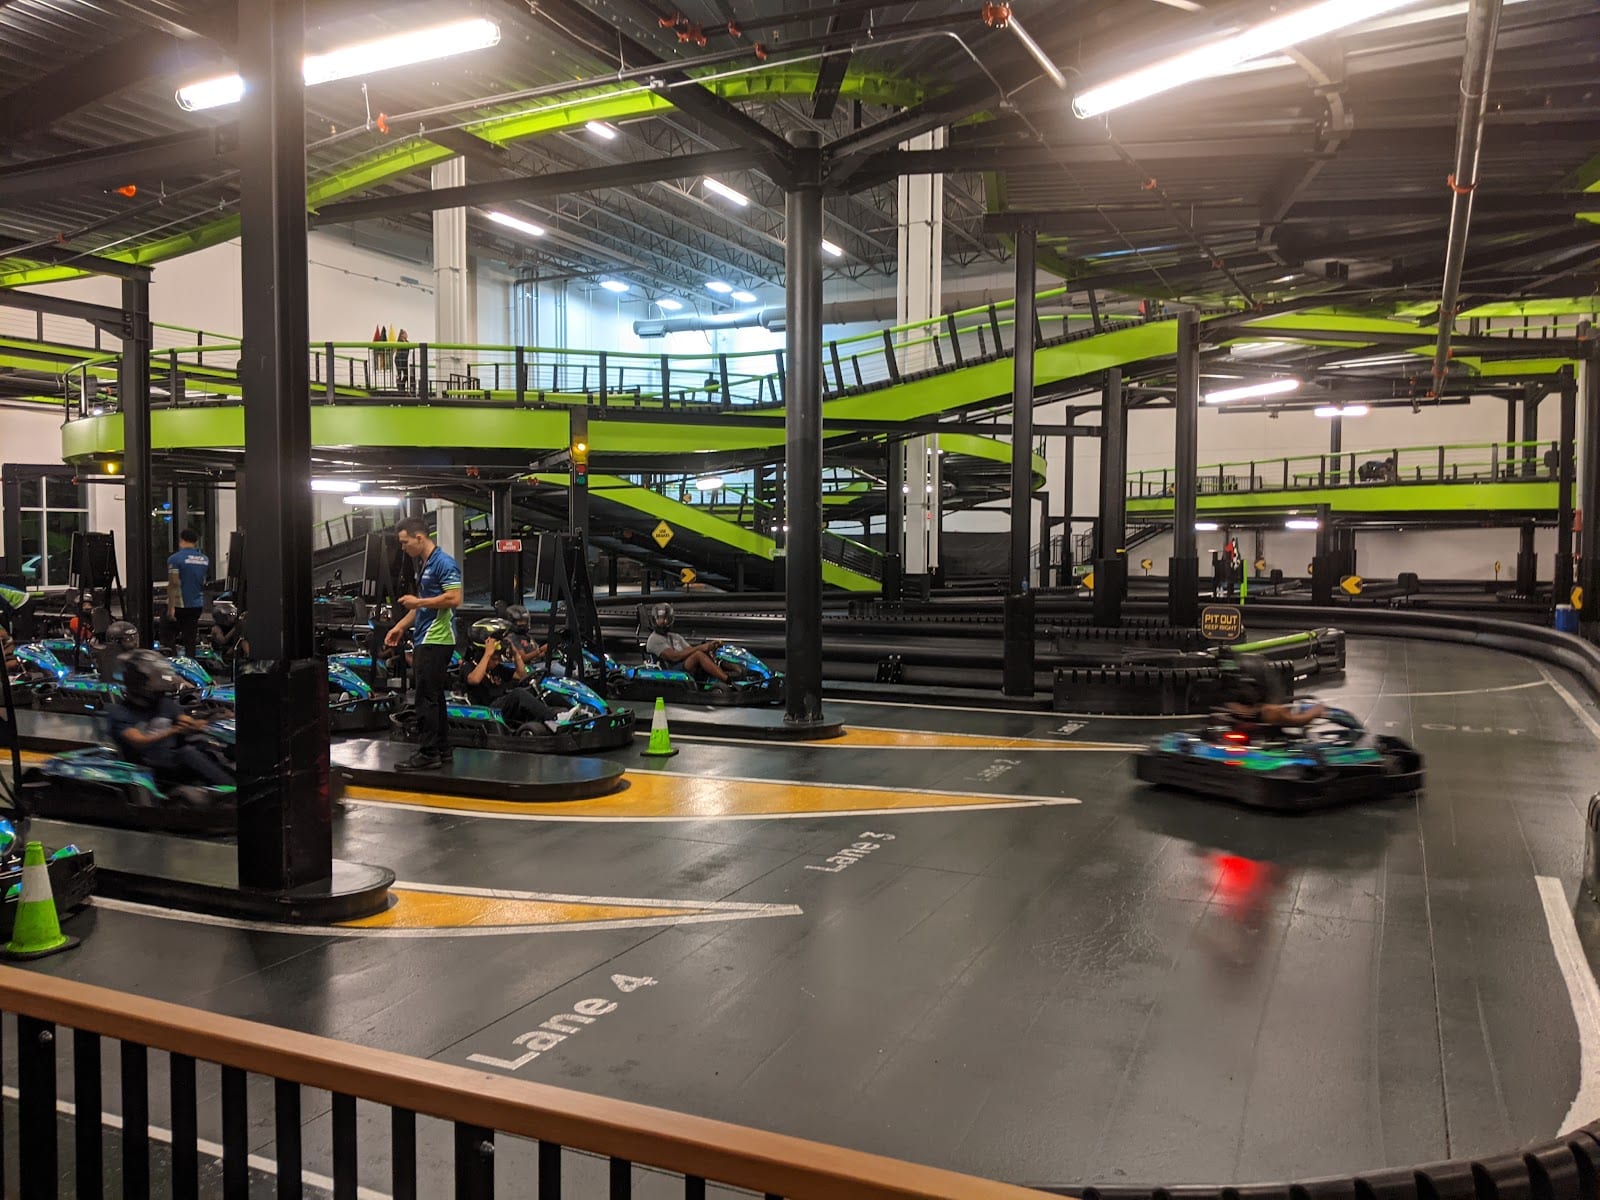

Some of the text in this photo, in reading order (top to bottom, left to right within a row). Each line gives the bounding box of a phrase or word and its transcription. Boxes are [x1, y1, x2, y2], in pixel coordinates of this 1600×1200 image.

[1204, 614, 1238, 625] PIT OUT
[994, 758, 1022, 766] 2
[803, 831, 896, 873] Lane 3
[465, 973, 660, 1071] Lane 4
